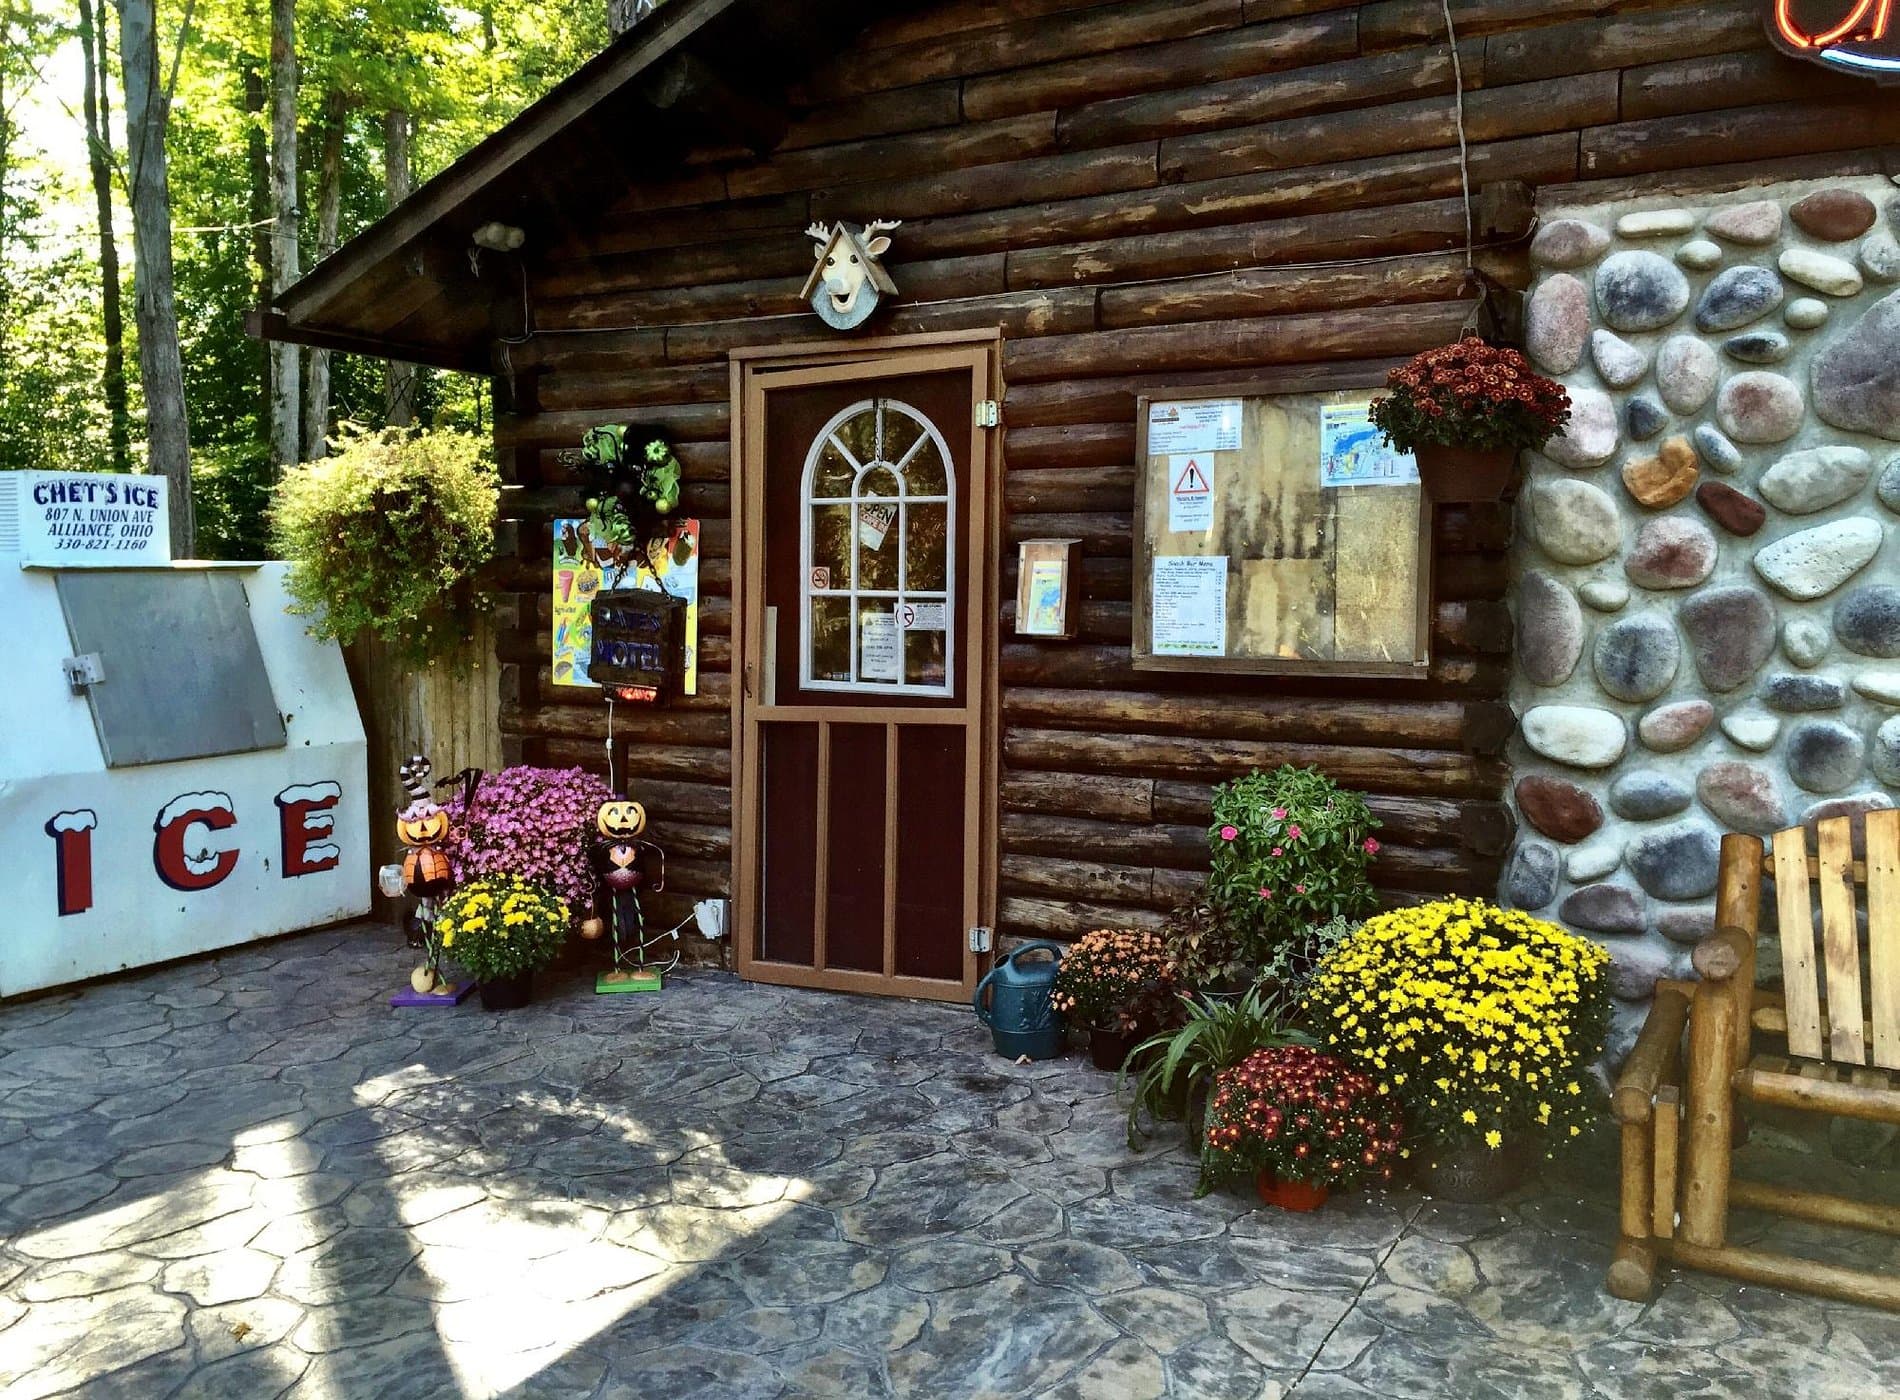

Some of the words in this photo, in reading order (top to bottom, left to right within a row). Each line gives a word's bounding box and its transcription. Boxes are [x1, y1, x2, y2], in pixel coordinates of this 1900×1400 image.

[34, 479, 118, 506] CHET'S
[124, 482, 160, 509] ICE
[45, 508, 68, 521] 807
[73, 510, 85, 522] N.
[90, 509, 130, 523] UNION
[131, 510, 154, 524] AVE
[48, 523, 115, 538] ALLIANCE,
[121, 524, 154, 538] OHIO
[597, 640, 665, 672] MOTEL
[44, 780, 343, 917] ICE
